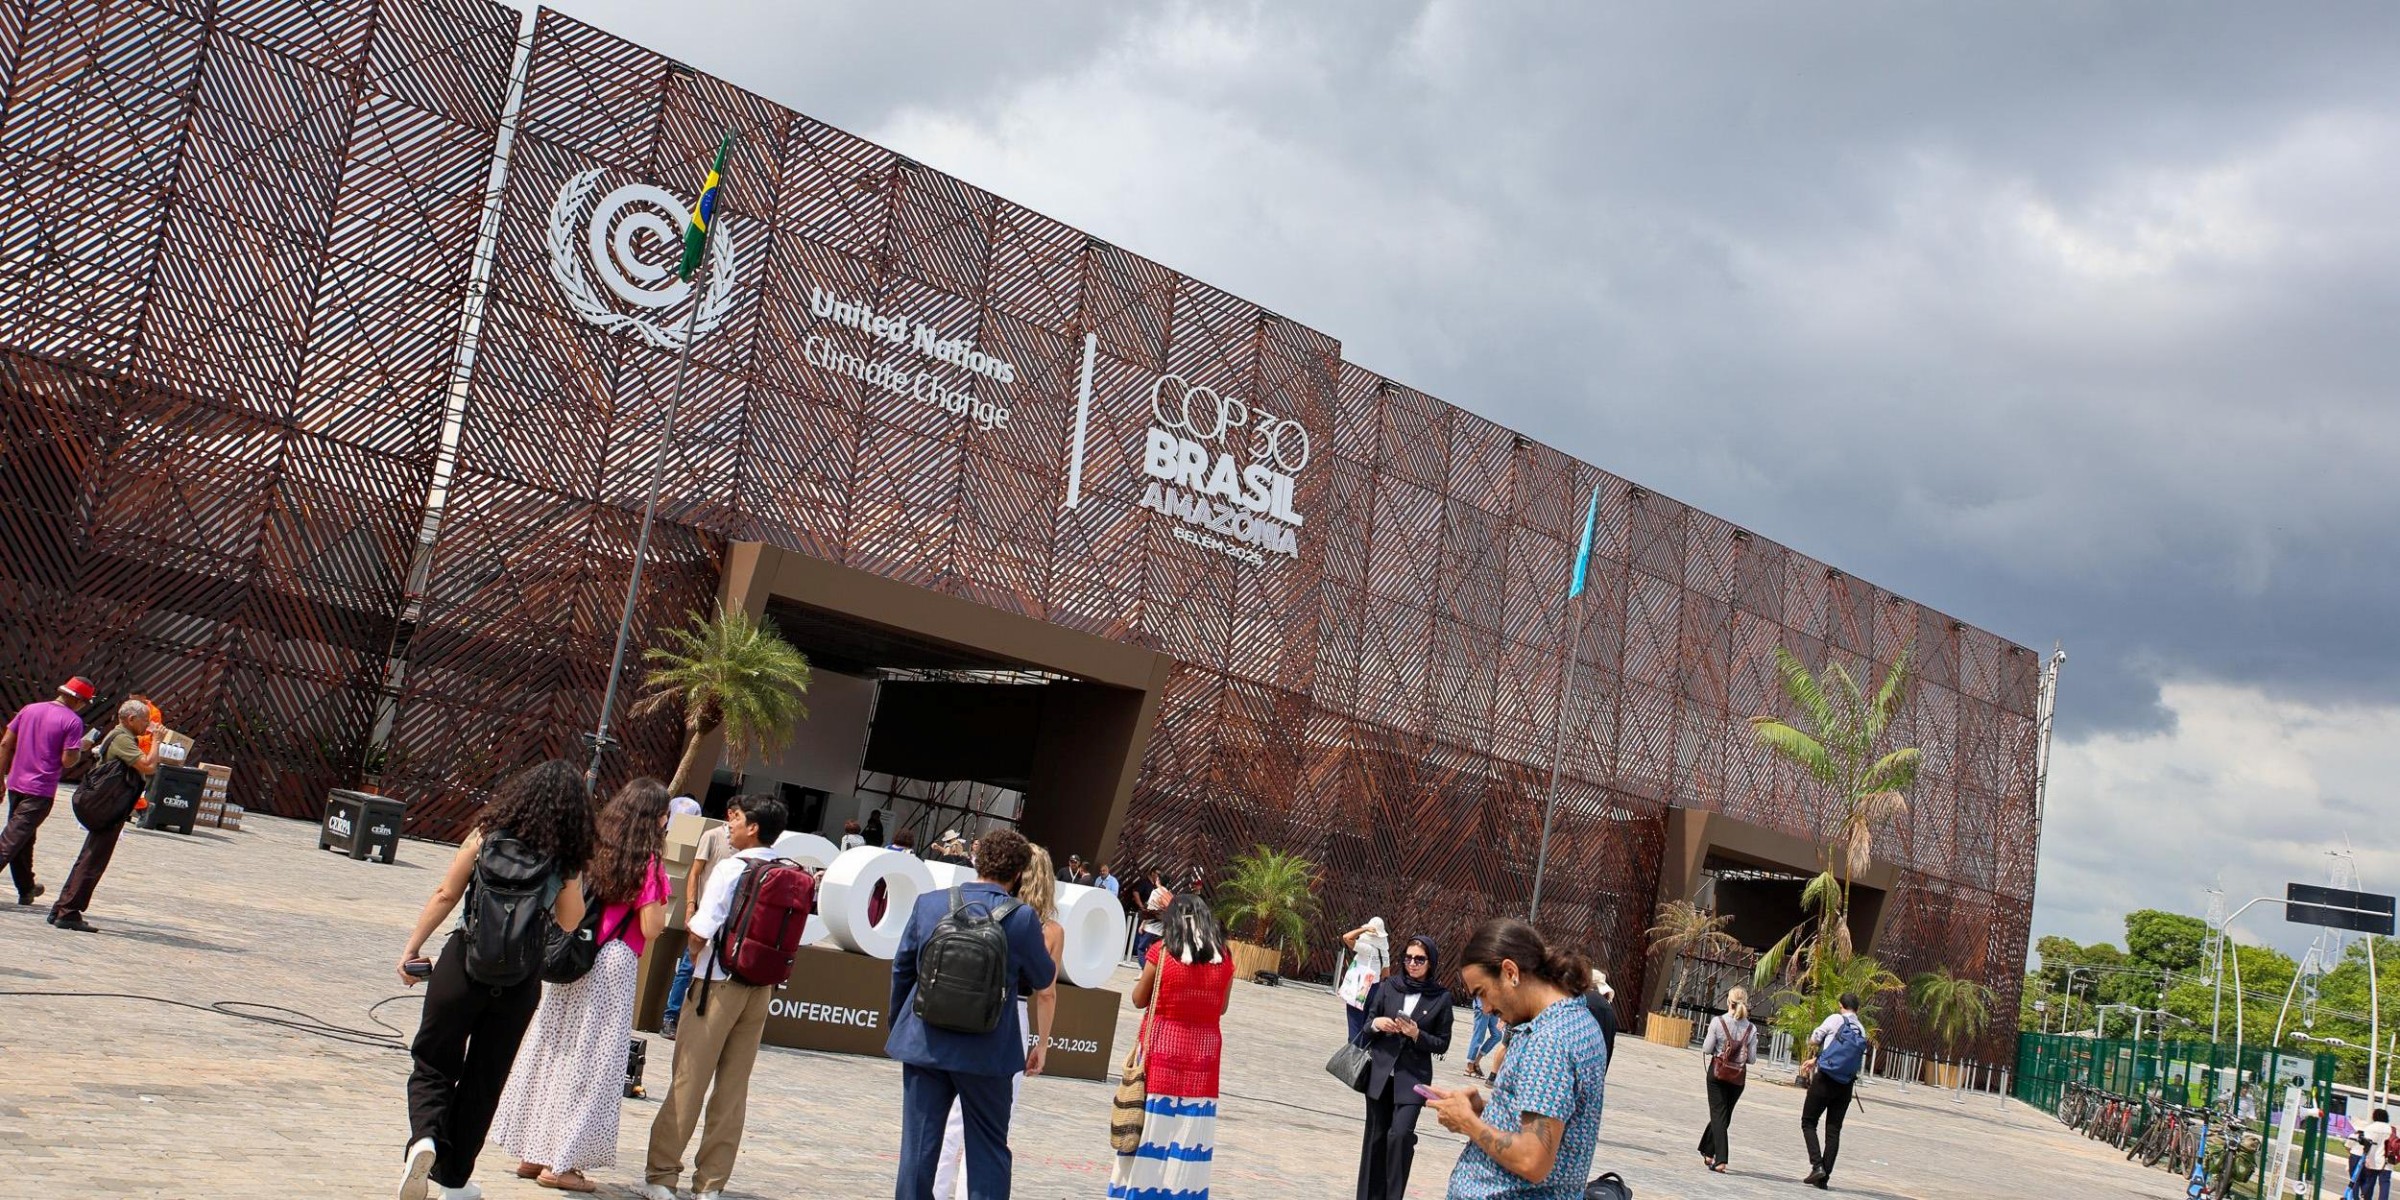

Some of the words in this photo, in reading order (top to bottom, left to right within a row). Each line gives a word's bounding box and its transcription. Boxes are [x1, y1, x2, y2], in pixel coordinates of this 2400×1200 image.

[811, 286, 908, 344] United
[912, 323, 1015, 384] Nations
[804, 336, 908, 394] Climate
[913, 372, 1010, 431] Change
[1152, 374, 1248, 445] COP
[1248, 407, 1310, 472] 30
[1144, 427, 1303, 527] BRASIL
[1139, 481, 1299, 559] AMAZÔNIA
[163, 796, 189, 809] CERPA
[328, 815, 351, 835] CERPA
[371, 826, 392, 836] CERPA
[768, 998, 879, 1028] ONFERENCE
[1047, 1036, 1098, 1053] 0-21,2025
